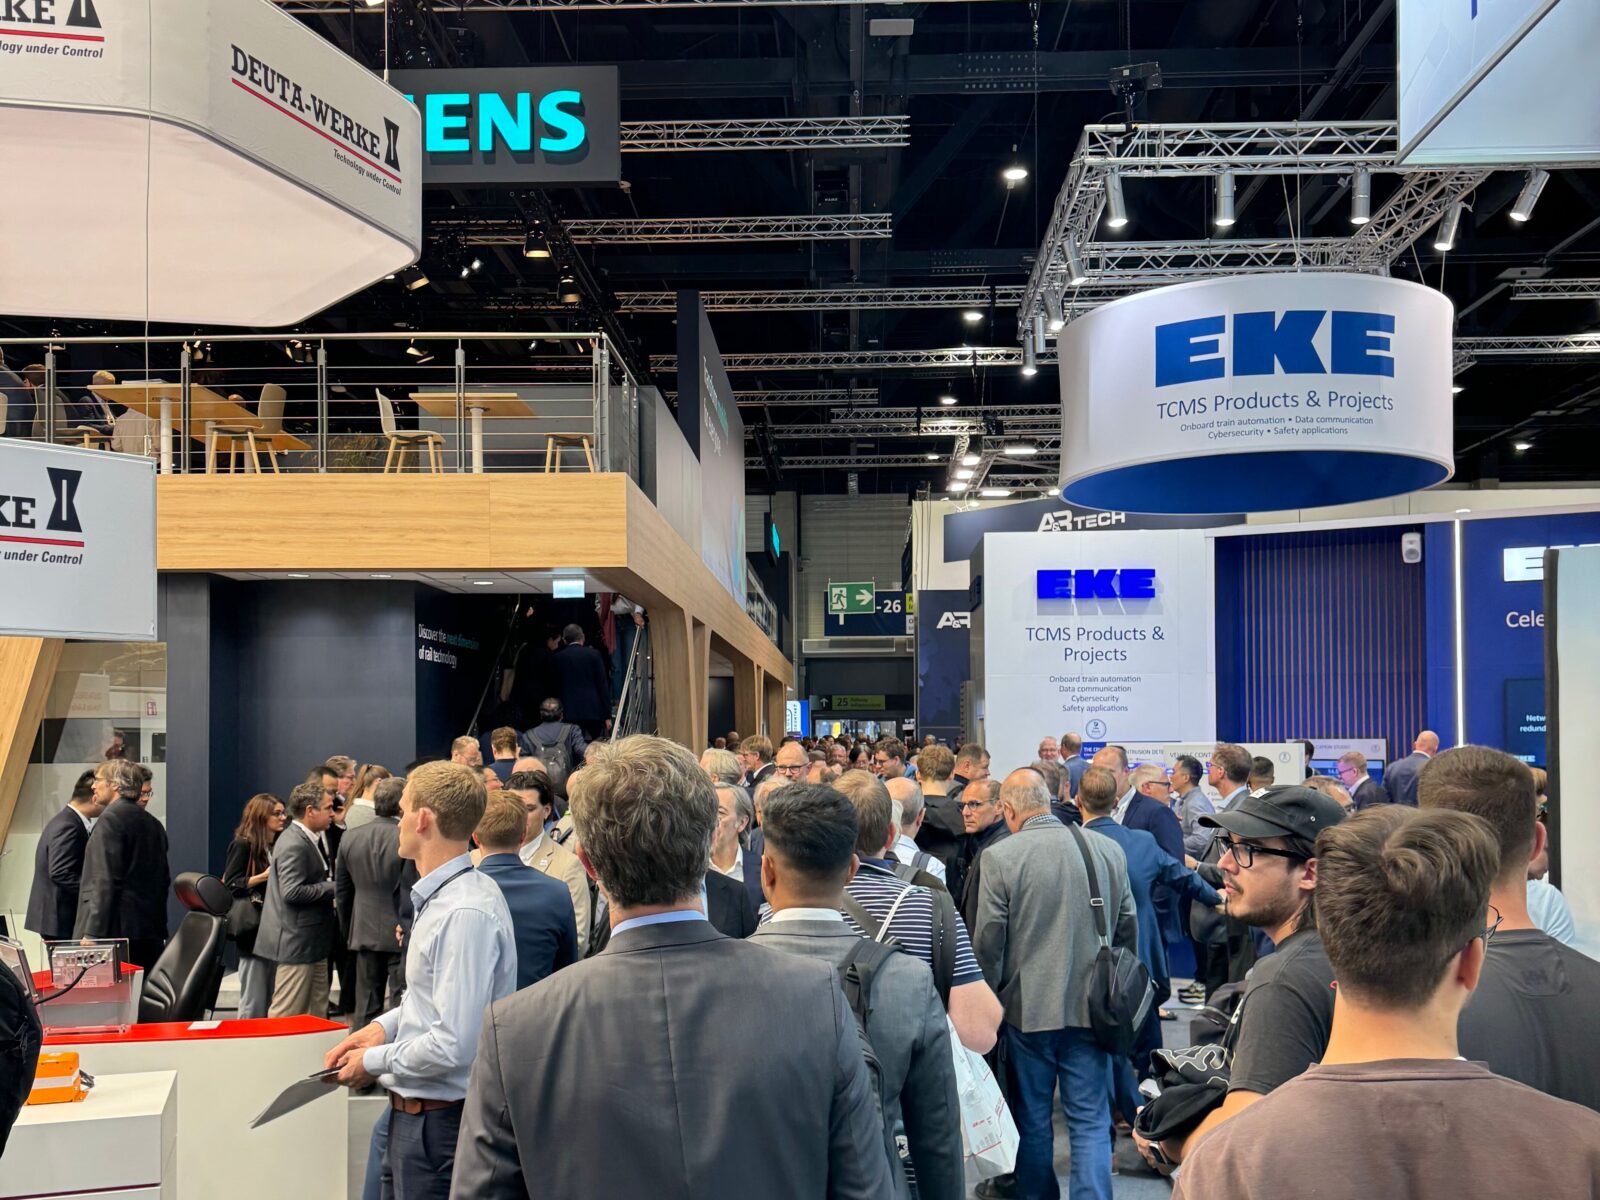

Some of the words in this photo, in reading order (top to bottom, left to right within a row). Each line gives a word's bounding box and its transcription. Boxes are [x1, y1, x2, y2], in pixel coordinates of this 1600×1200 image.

[26, 44, 59, 55] under
[62, 45, 104, 58] Control
[231, 43, 381, 160] DEUTA-WERKE
[404, 89, 586, 152] ENS
[333, 148, 366, 176] Technology
[366, 170, 382, 184] under
[382, 178, 402, 196] Control
[1155, 310, 1395, 388] EKE
[1156, 397, 1207, 419] TCMS
[1214, 392, 1299, 412] Products
[1306, 390, 1321, 408] &
[1328, 391, 1394, 412] Projects
[1180, 420, 1215, 431] Onboard
[1217, 417, 1236, 427] train
[1237, 415, 1286, 426] automation
[1295, 415, 1314, 424] Data
[1316, 415, 1374, 425] communication
[1208, 428, 1264, 440] Cybersecurity
[1273, 426, 1300, 436] Safety
[1301, 426, 1348, 436] applications
[4, 549, 39, 562] under
[41, 551, 83, 565] Control
[1037, 568, 1156, 599] EKE
[1506, 610, 1545, 628] Cele
[1025, 627, 1071, 641] TCMS
[1077, 626, 1147, 641] Products
[1152, 626, 1165, 641] &
[1064, 647, 1128, 664] Projects
[1049, 675, 1081, 683] Onboard
[1081, 675, 1099, 683] train
[1100, 675, 1142, 683] automation
[1059, 685, 1076, 693] Data
[1077, 685, 1132, 693] communication
[1071, 694, 1120, 704] Cybersecurity
[1062, 705, 1085, 713] Safety
[1086, 704, 1129, 713] applications
